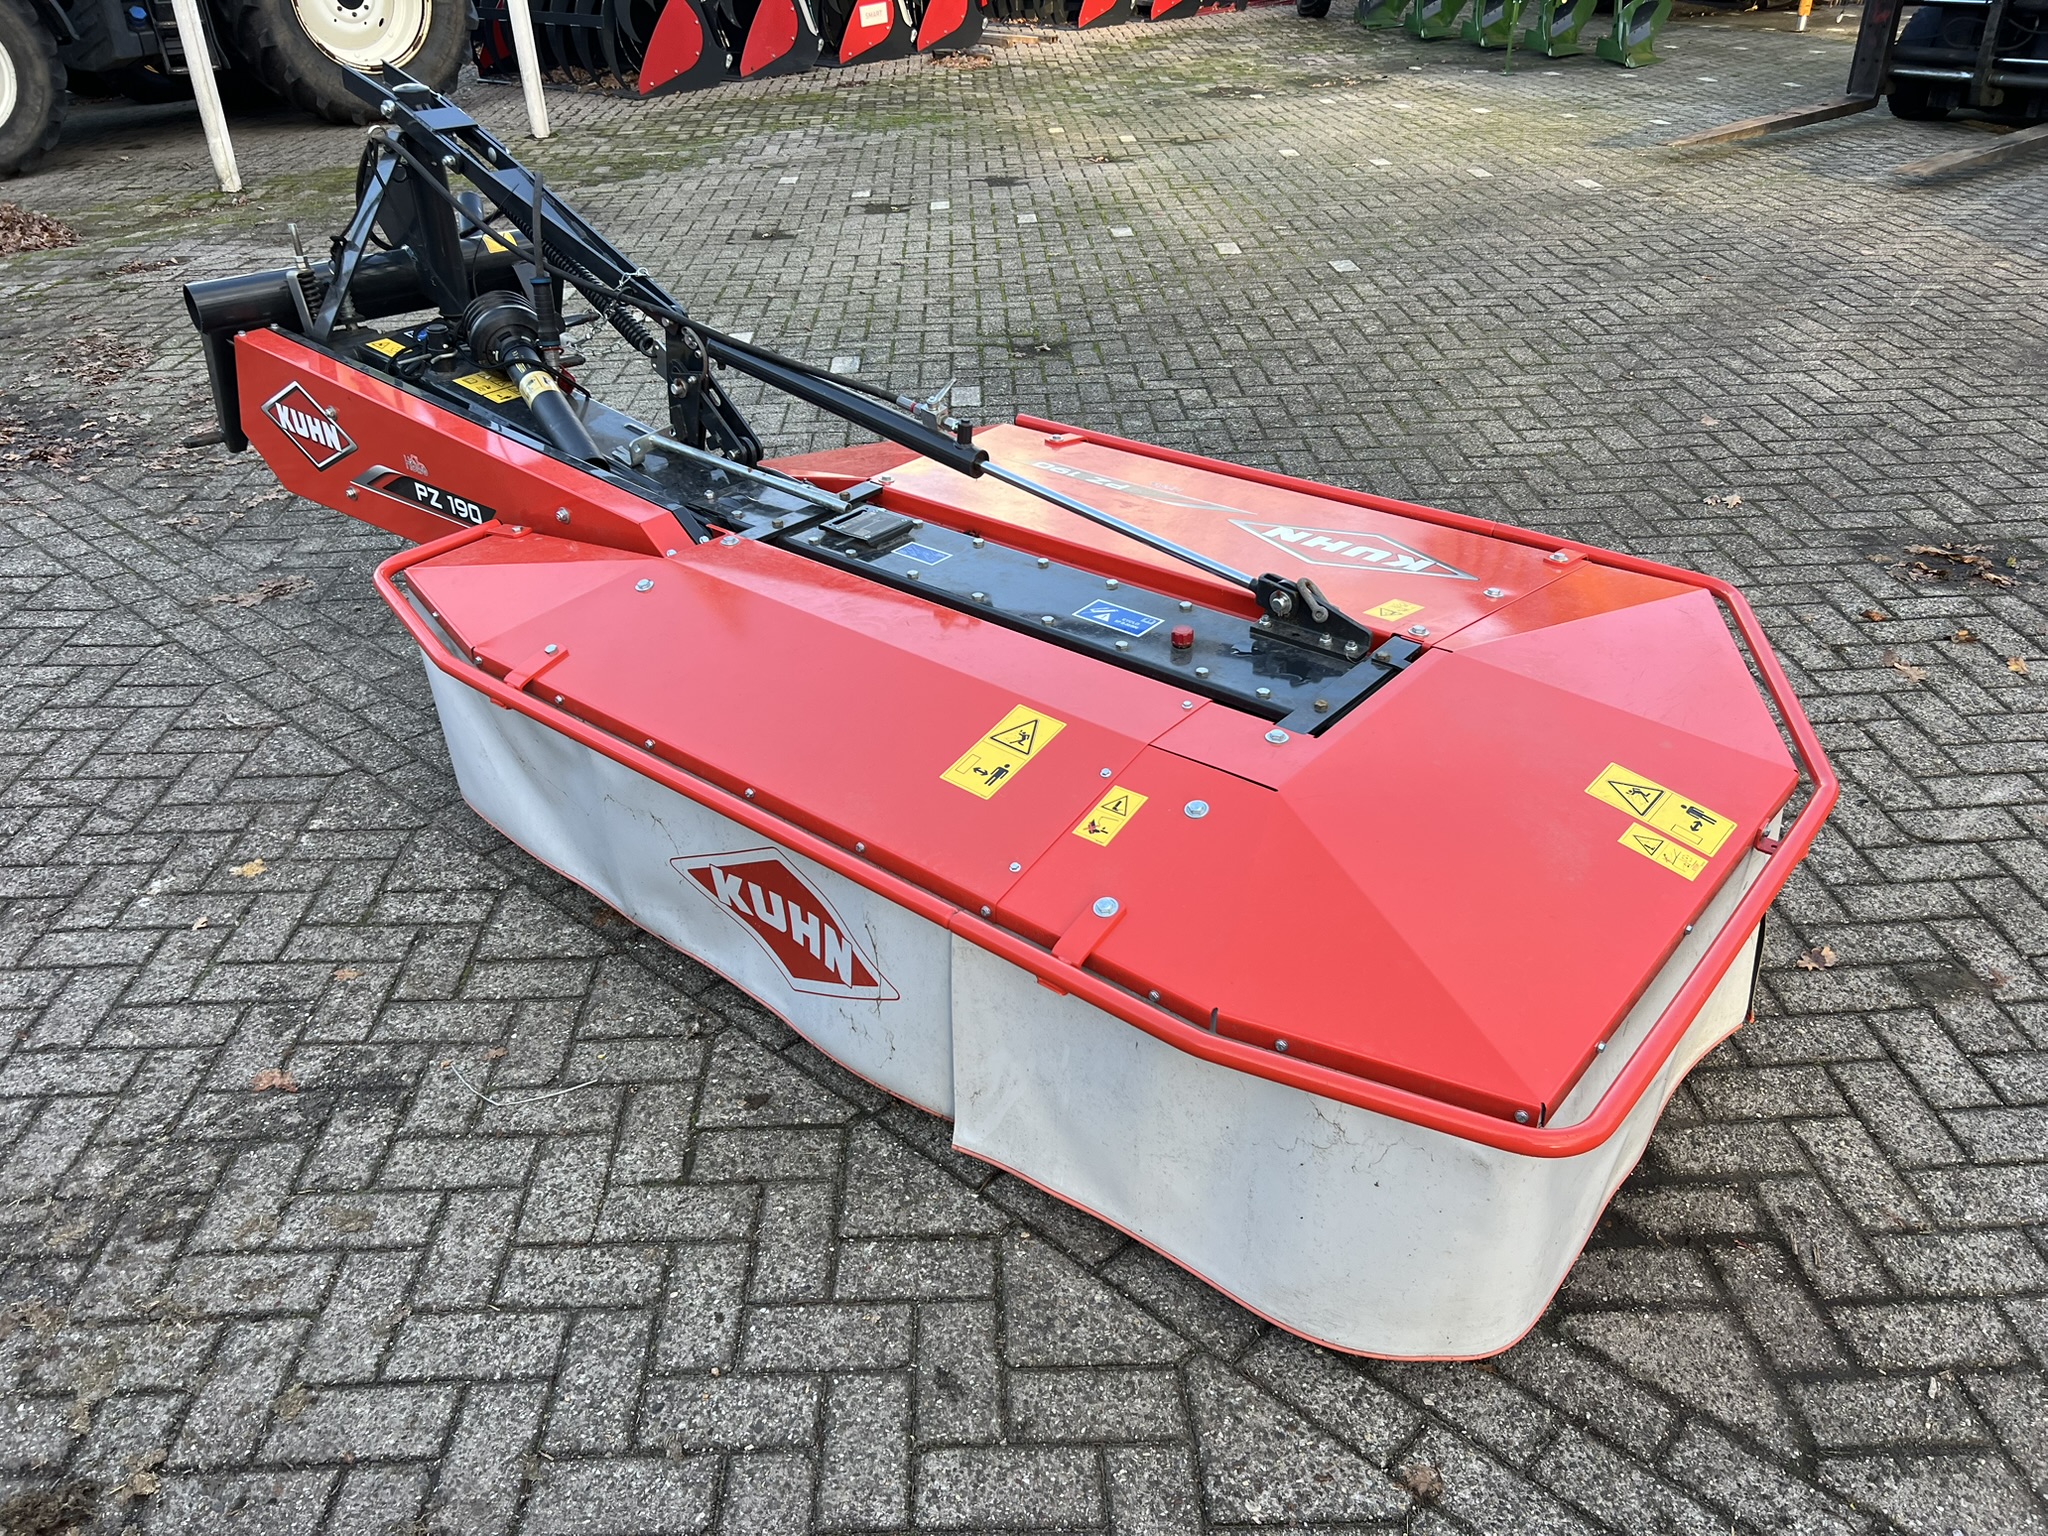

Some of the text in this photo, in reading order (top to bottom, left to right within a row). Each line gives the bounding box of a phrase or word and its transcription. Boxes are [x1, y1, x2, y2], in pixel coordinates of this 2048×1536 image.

[865, 9, 883, 19] SMART
[274, 402, 343, 452] KUHN
[1031, 460, 1130, 491] PZ 190
[414, 481, 483, 525] PZ 190
[1260, 525, 1436, 573] KUHN
[709, 863, 853, 989] KUHN
